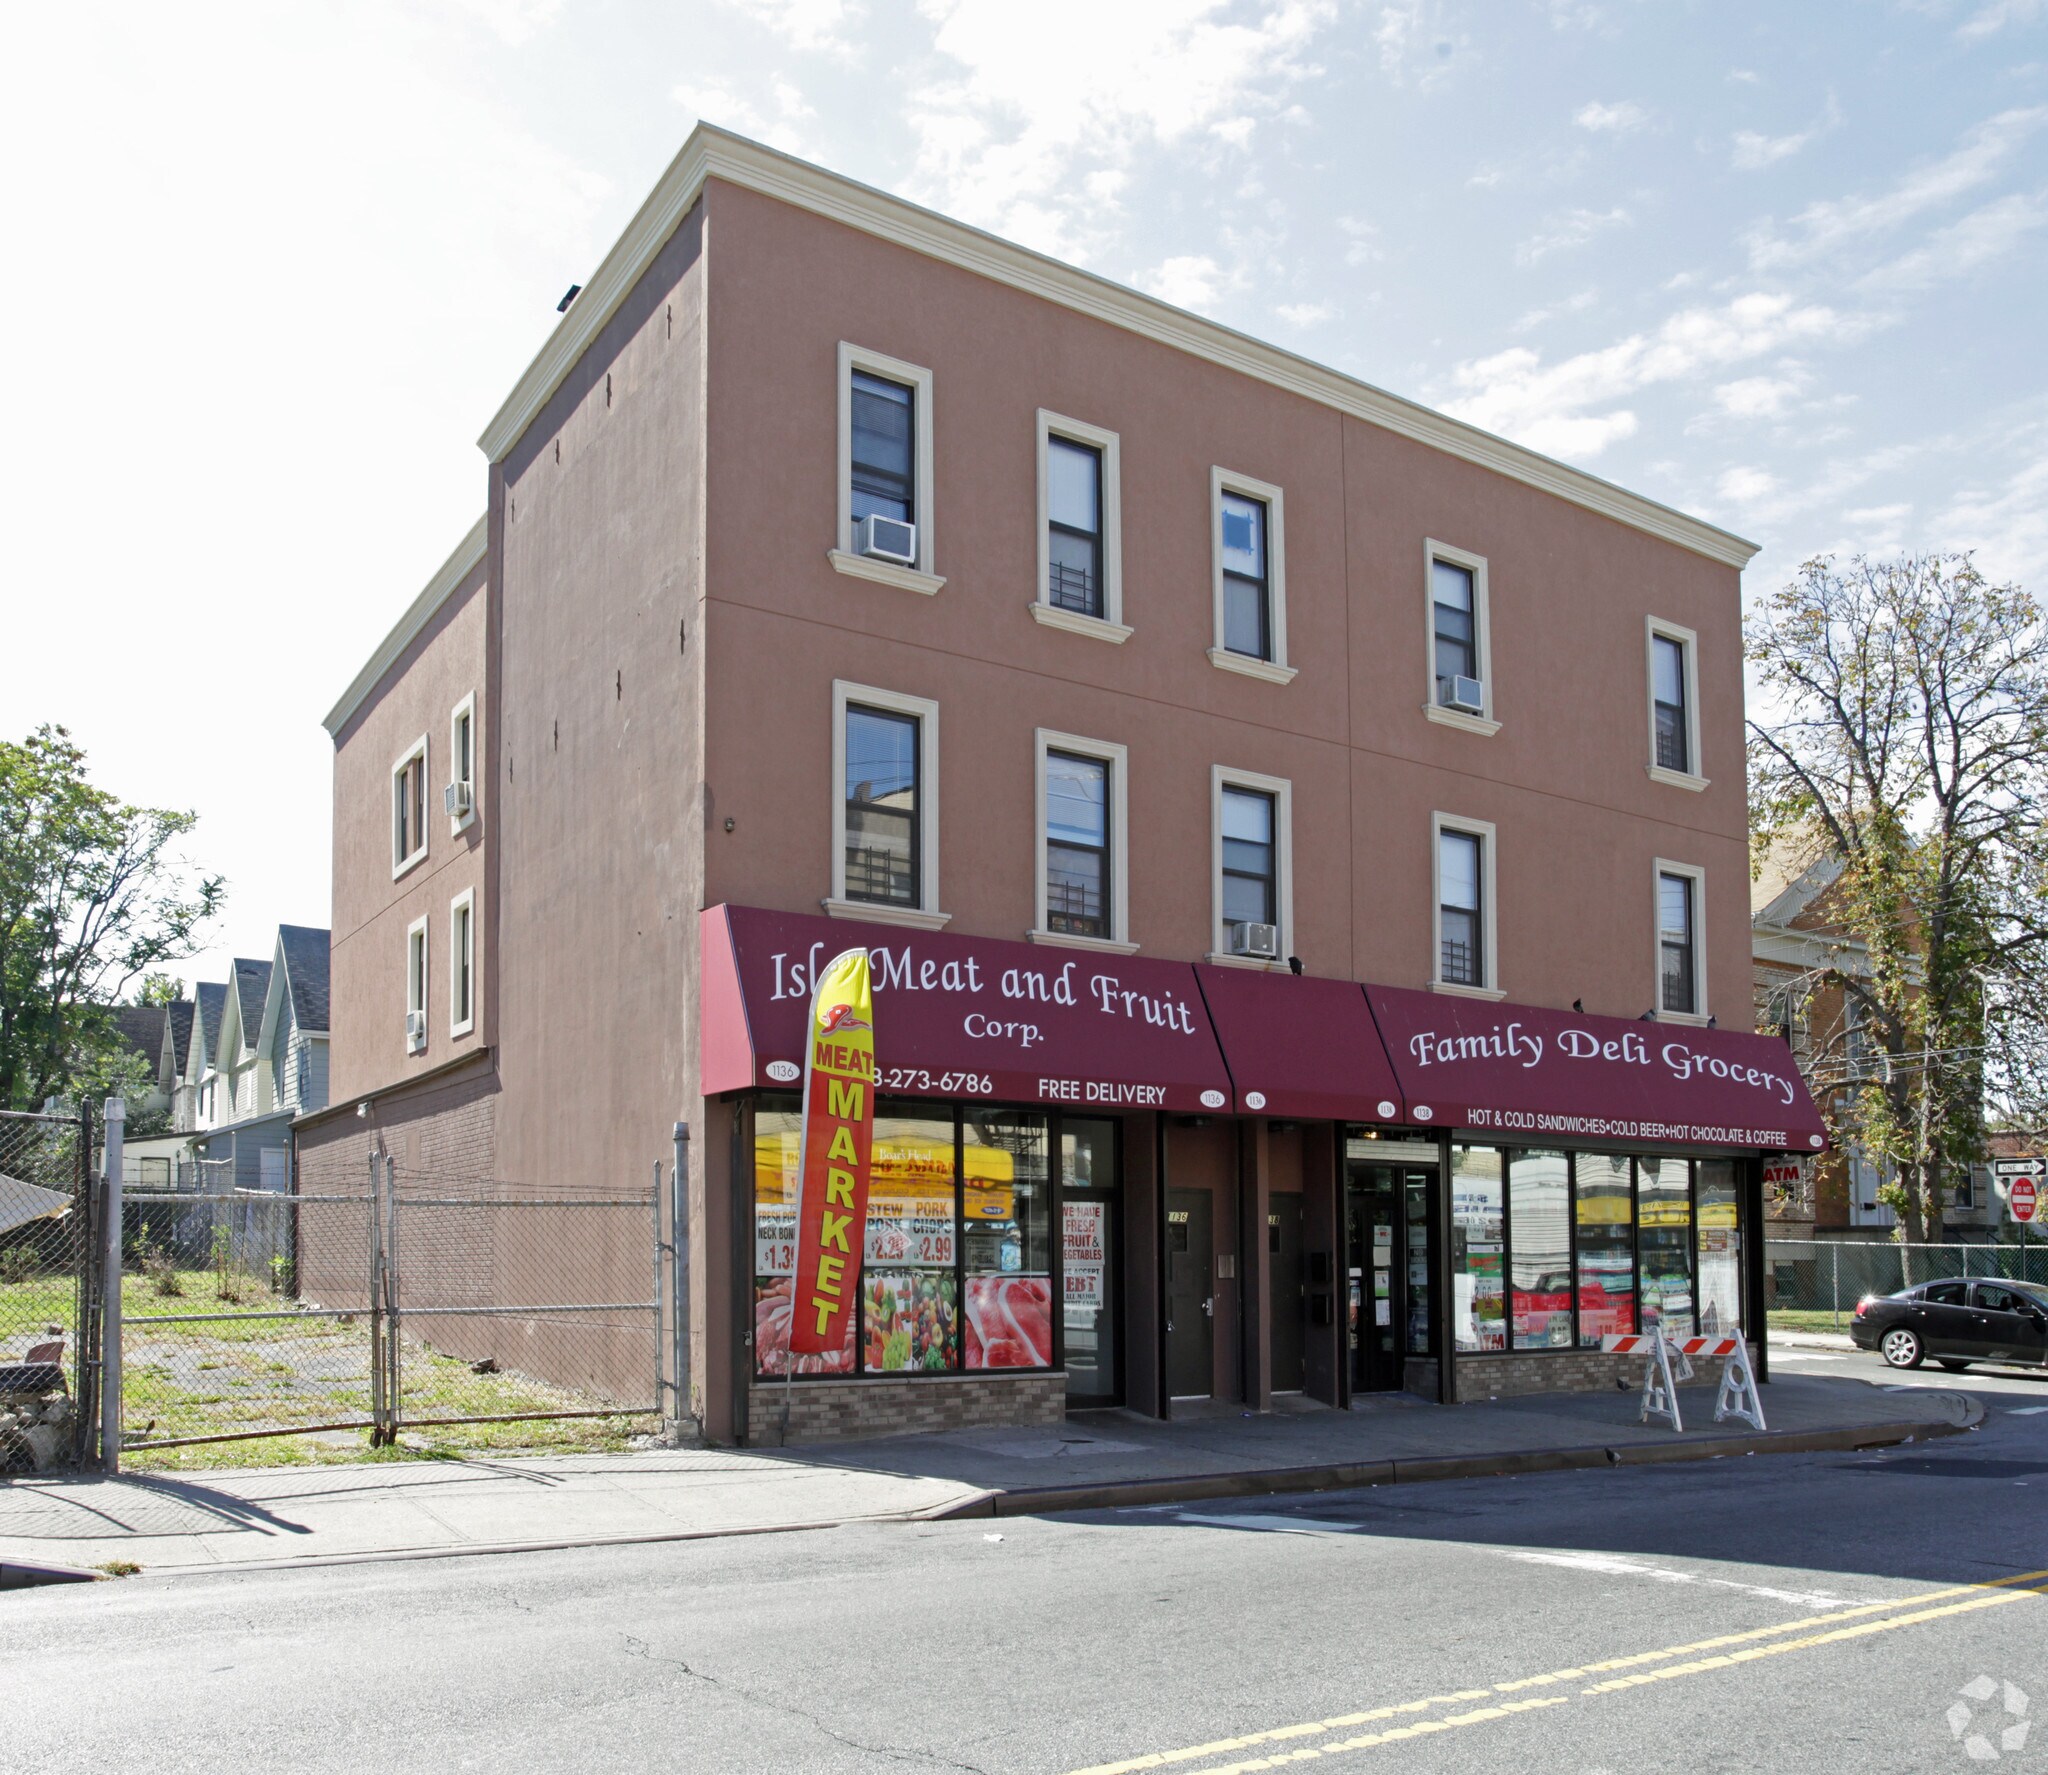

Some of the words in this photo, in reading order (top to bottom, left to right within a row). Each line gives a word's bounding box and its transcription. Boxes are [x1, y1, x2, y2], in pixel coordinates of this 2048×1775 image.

[770, 941, 825, 1001] Isl
[869, 946, 984, 993] Meat
[1001, 962, 1077, 1006] and
[1090, 974, 1196, 1035] Fruit
[964, 1013, 1045, 1048] Corp.
[816, 1041, 873, 1075] MEAT
[1409, 1022, 1543, 1068] Family
[1557, 1029, 1651, 1065] Deli
[1661, 1043, 1795, 1105] Grocery
[772, 1064, 794, 1078] 1136
[873, 1067, 993, 1094] 8-273-6786
[1038, 1078, 1080, 1100] FREE
[1086, 1081, 1167, 1105] DELIVERY
[1203, 1093, 1221, 1105] 1136
[1249, 1092, 1264, 1106] 1136
[1416, 1108, 1431, 1119] 1138
[1467, 1108, 1492, 1126] HOT
[1494, 1112, 1502, 1126] &
[1504, 1111, 1535, 1128] COLD
[1690, 1125, 1744, 1143] CHOCOLATE
[1745, 1129, 1752, 1143] &
[1753, 1130, 1788, 1146] COFFEE
[879, 1148, 906, 1161] Boar's
[907, 1150, 932, 1161] Head
[1763, 1166, 1800, 1181] ATM
[2001, 1164, 2017, 1172] ONE
[811, 1078, 865, 1336] MARKET
[867, 1203, 904, 1217] STEW
[916, 1202, 948, 1217] PORK
[1077, 1206, 1100, 1218] HAVE
[2017, 1205, 2031, 1213] ENTER
[913, 1218, 952, 1234] CHOPS
[1066, 1220, 1095, 1233] FRESH
[758, 1227, 777, 1240] NECK
[778, 1227, 795, 1240] BON
[1063, 1234, 1092, 1248] FRUIT
[1092, 1236, 1100, 1248] &
[918, 1236, 953, 1262] $2.99
[1063, 1249, 1102, 1261] EGETABLES
[1065, 1276, 1097, 1293] EBT
